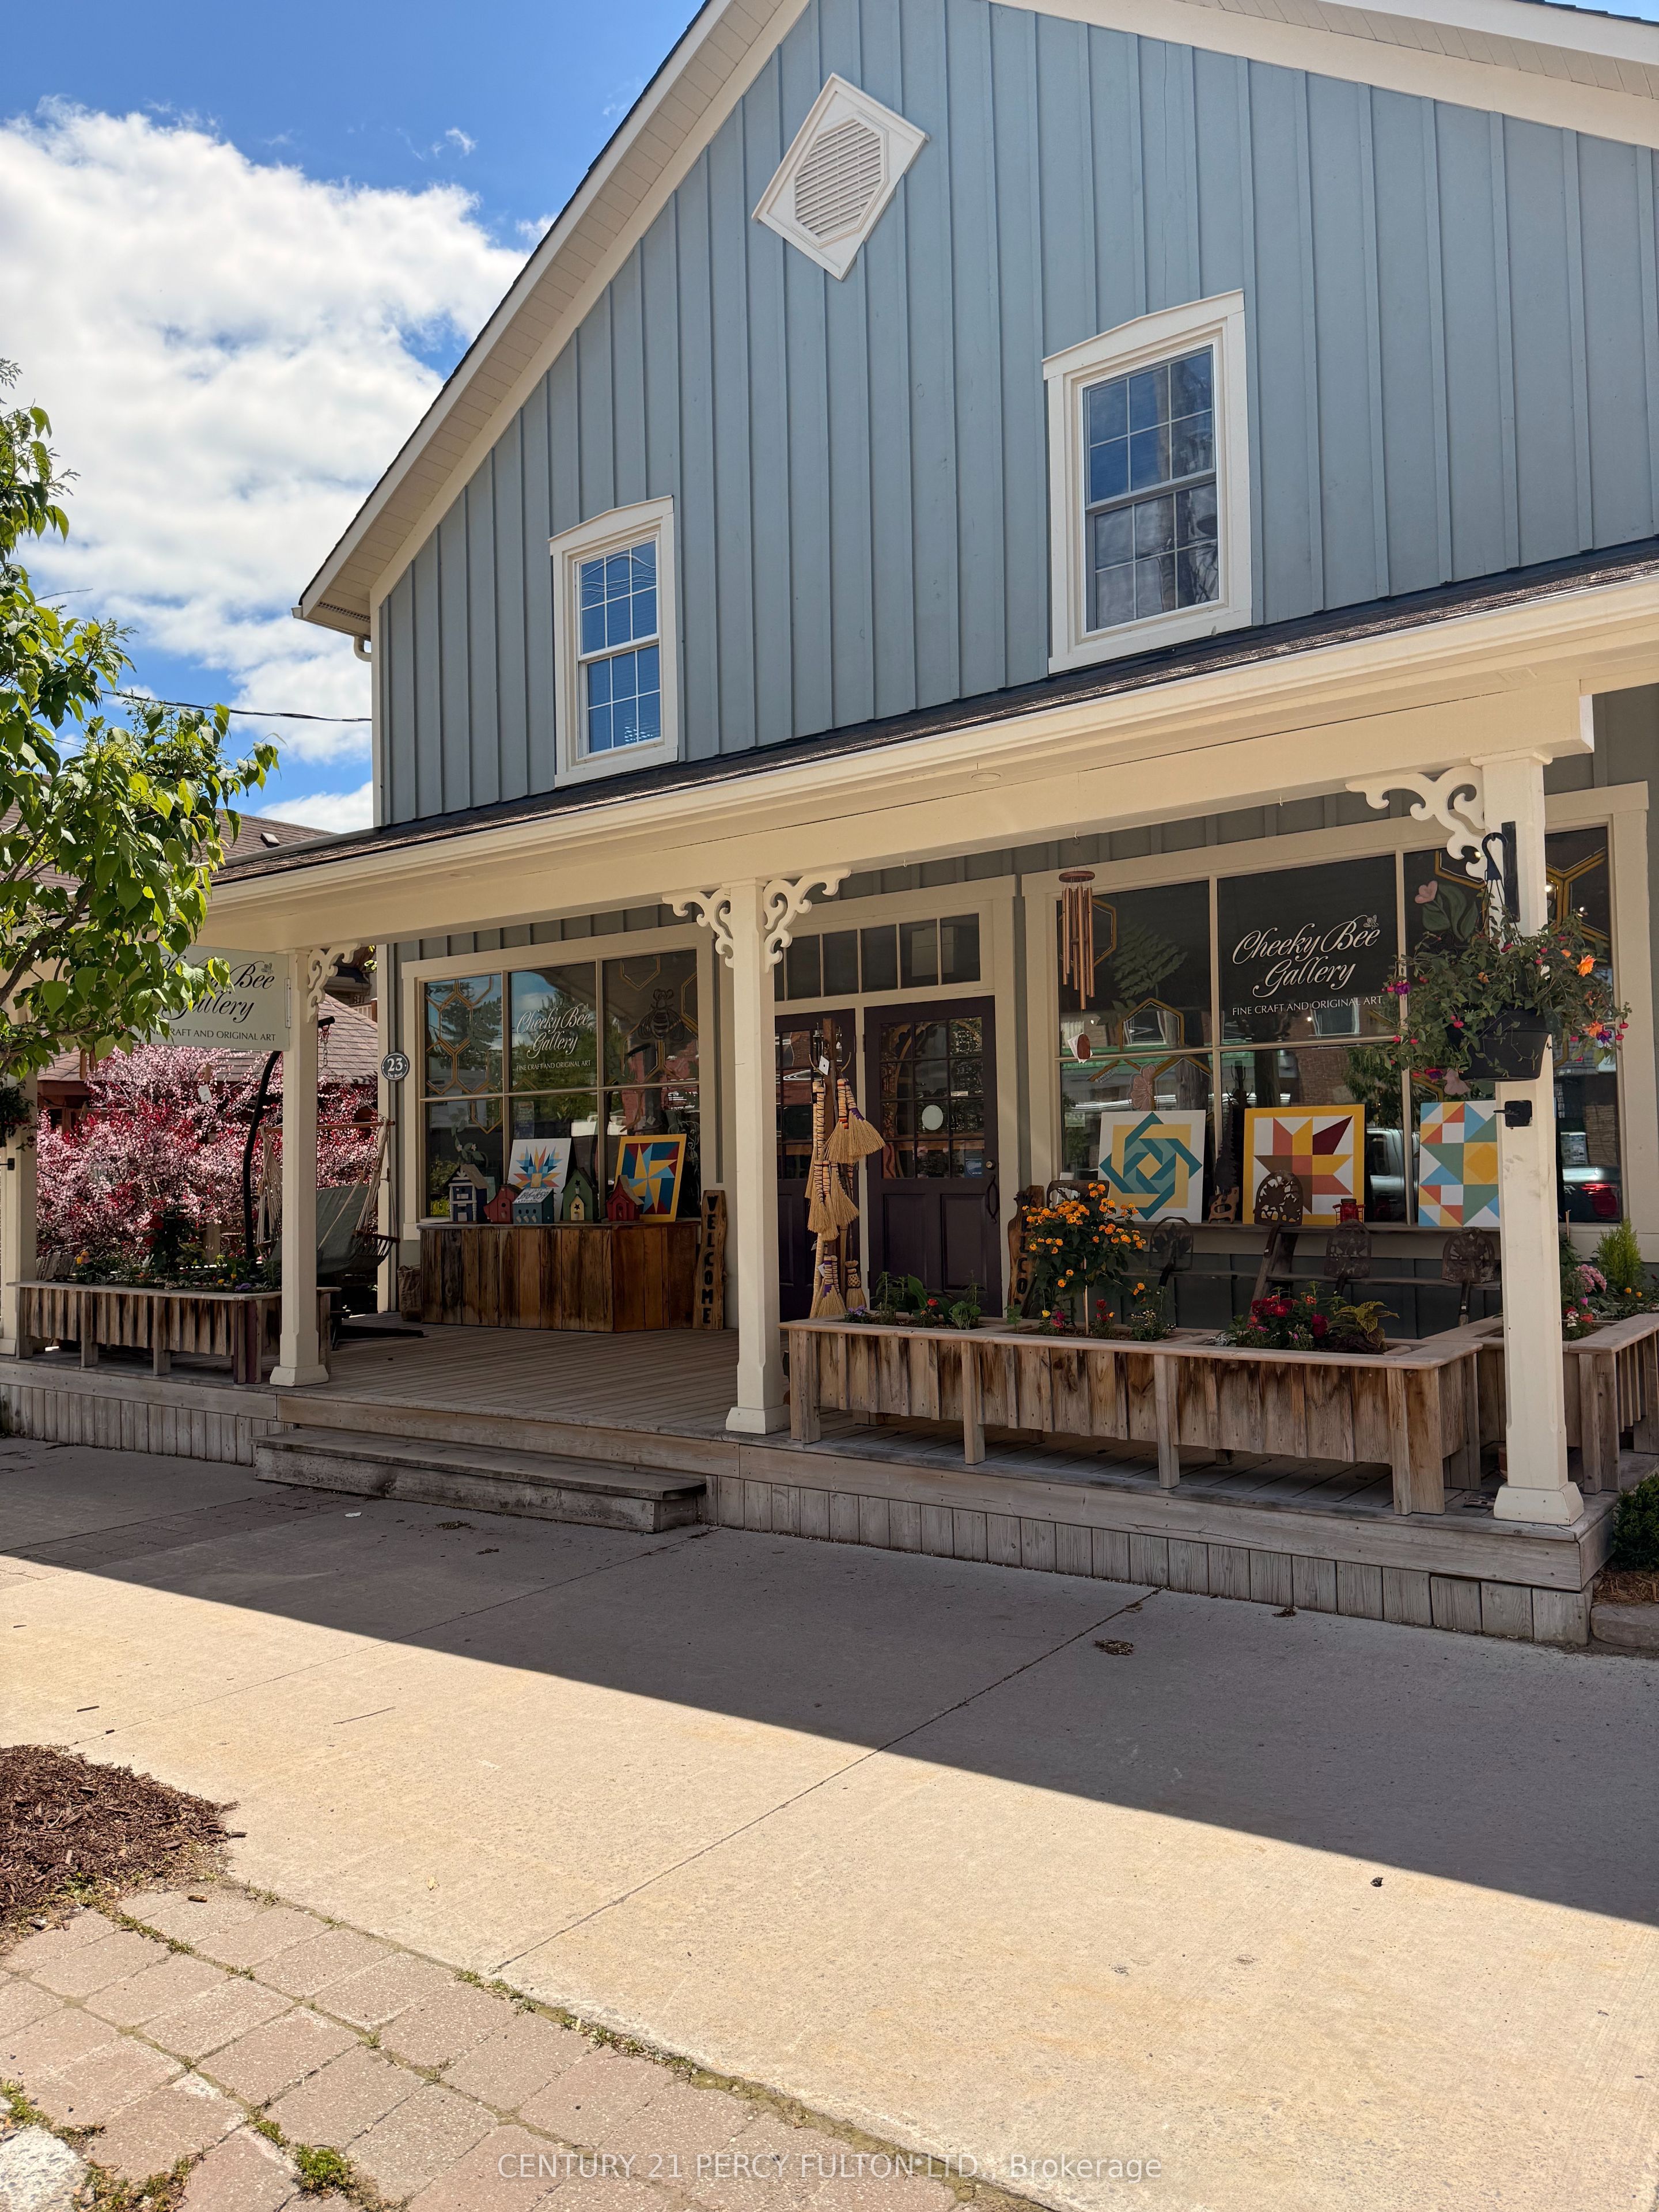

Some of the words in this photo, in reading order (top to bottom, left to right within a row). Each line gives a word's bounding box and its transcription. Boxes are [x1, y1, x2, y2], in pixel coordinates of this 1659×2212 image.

[1232, 923, 1321, 964] Cheeky
[1320, 915, 1381, 952] Bee
[230, 961, 275, 989] Bee
[1252, 956, 1357, 998] Gallery
[517, 1007, 561, 1034] Cheeky
[560, 1003, 590, 1028] Bee
[1232, 1006, 1252, 1016] FINE
[1255, 1003, 1285, 1014] CRAFT
[1286, 1002, 1309, 1011] AND
[1312, 998, 1361, 1009] ORIGINAL
[1363, 995, 1382, 1005] ART
[171, 1028, 192, 1037] RAFT
[194, 1029, 214, 1038] AND
[216, 1031, 258, 1040] ORIGINAL
[260, 1033, 276, 1041] ART
[527, 1031, 578, 1059] Gallery
[387, 1058, 403, 1072] 23
[702, 1195, 718, 1324] WELCOME
[1014, 1194, 1033, 1304] WELCO
